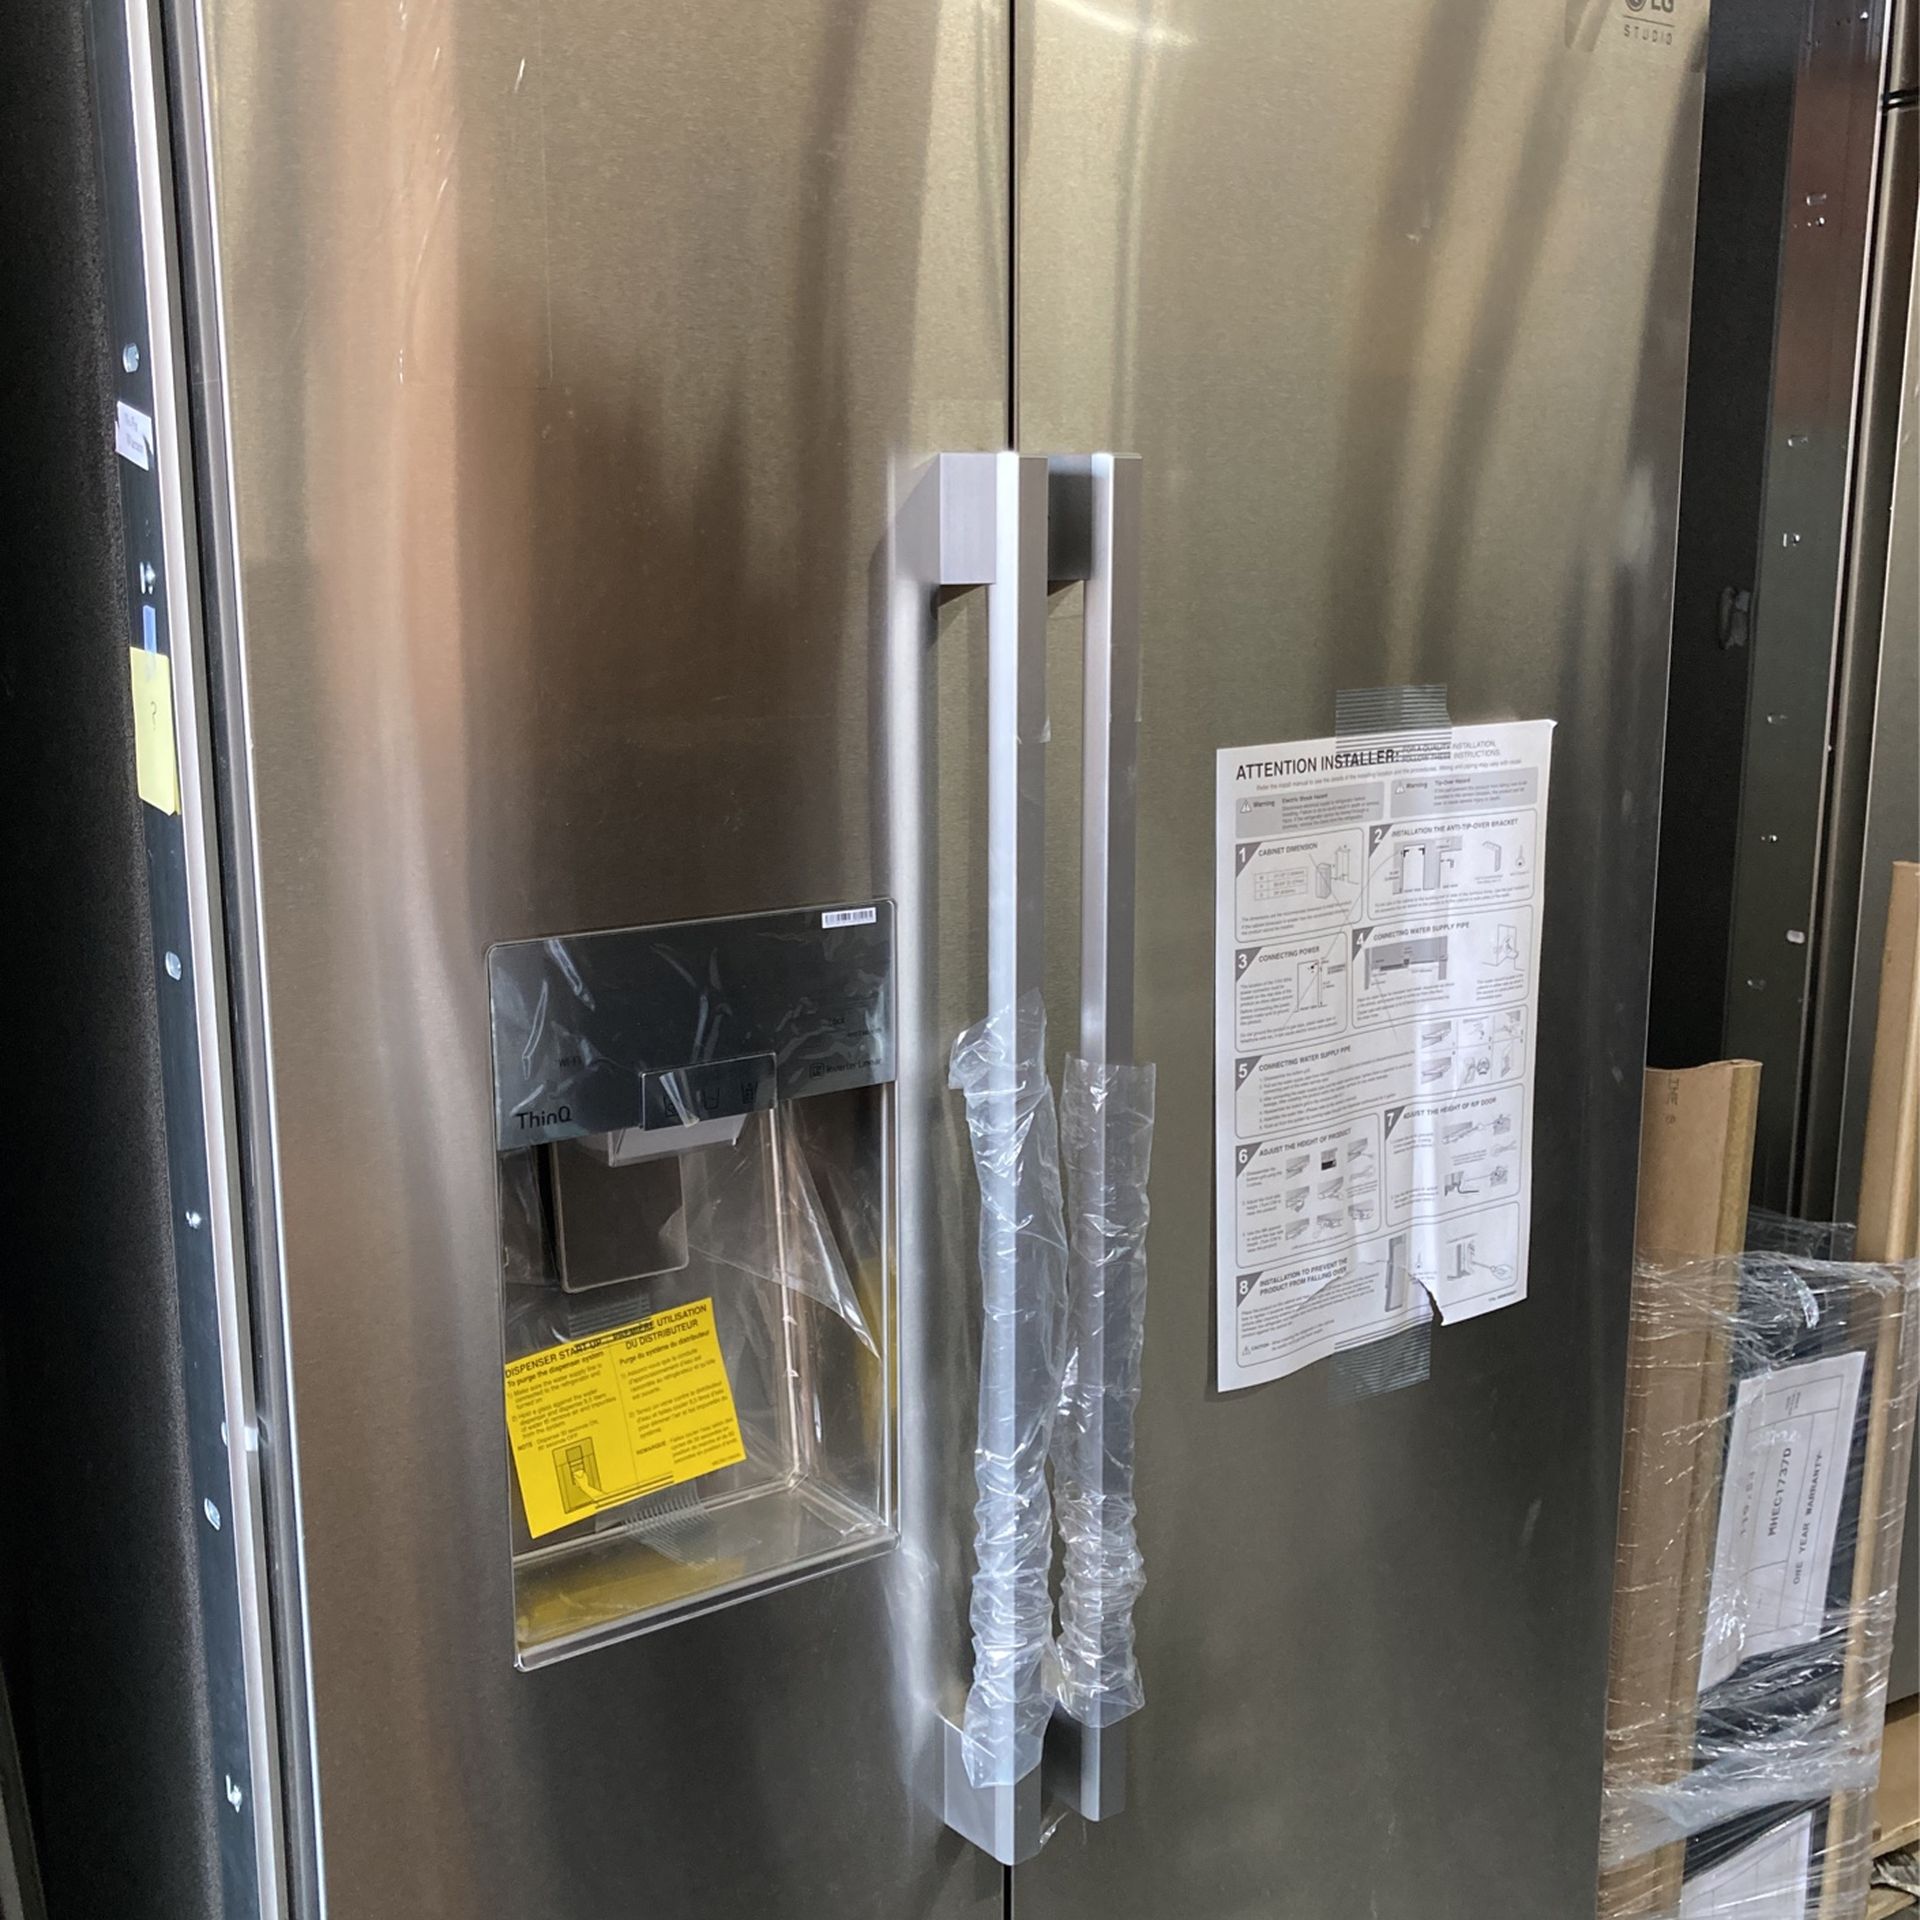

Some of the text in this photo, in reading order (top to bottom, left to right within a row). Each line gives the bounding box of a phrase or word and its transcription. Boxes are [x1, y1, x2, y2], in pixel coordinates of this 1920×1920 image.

[1651, 0, 1674, 13] LG
[1623, 24, 1673, 45] STUDIO
[1236, 757, 1317, 780] ATTENTION
[1253, 799, 1274, 808] Warning
[1392, 826, 1432, 838] INSTALLATION
[1490, 817, 1518, 827] BRACKET
[1374, 829, 1382, 843] 2
[1239, 847, 1245, 863] 1
[1258, 842, 1317, 857] CABINET DIMENSION
[1356, 932, 1363, 945] 4
[1373, 921, 1469, 941] CONNECTING WATER SUPPLY PIPE
[1238, 953, 1247, 969] 3
[1258, 945, 1319, 962] CONNECTING POWER
[1320, 1048, 1339, 1059] SUPPLY
[1238, 1063, 1248, 1079] 5
[1427, 1106, 1439, 1116] THE
[1462, 1101, 1469, 1109] OF
[516, 1106, 572, 1130] ThinQ
[1386, 1112, 1393, 1127] 7
[1238, 1149, 1247, 1164] 6
[1258, 1144, 1283, 1157] ADJUST
[1284, 1141, 1295, 1151] THE
[1259, 1256, 1347, 1287] INSTALLATION TO PREVENT THE
[1239, 1279, 1248, 1296] 8
[1259, 1282, 1288, 1296] PRODUCT
[1289, 1277, 1305, 1287] FROM
[1306, 1269, 1331, 1283] FALLING
[656, 1304, 707, 1327] UTILISATION
[625, 1319, 699, 1350] DU DISTRIBUTEUR
[505, 1354, 557, 1378] DISPENSER
[537, 1369, 548, 1378] the
[1768, 1447, 1792, 1537] MHEC1737D
[1793, 1561, 1804, 1585] ONE
[1799, 1523, 1811, 1554] YEAR
